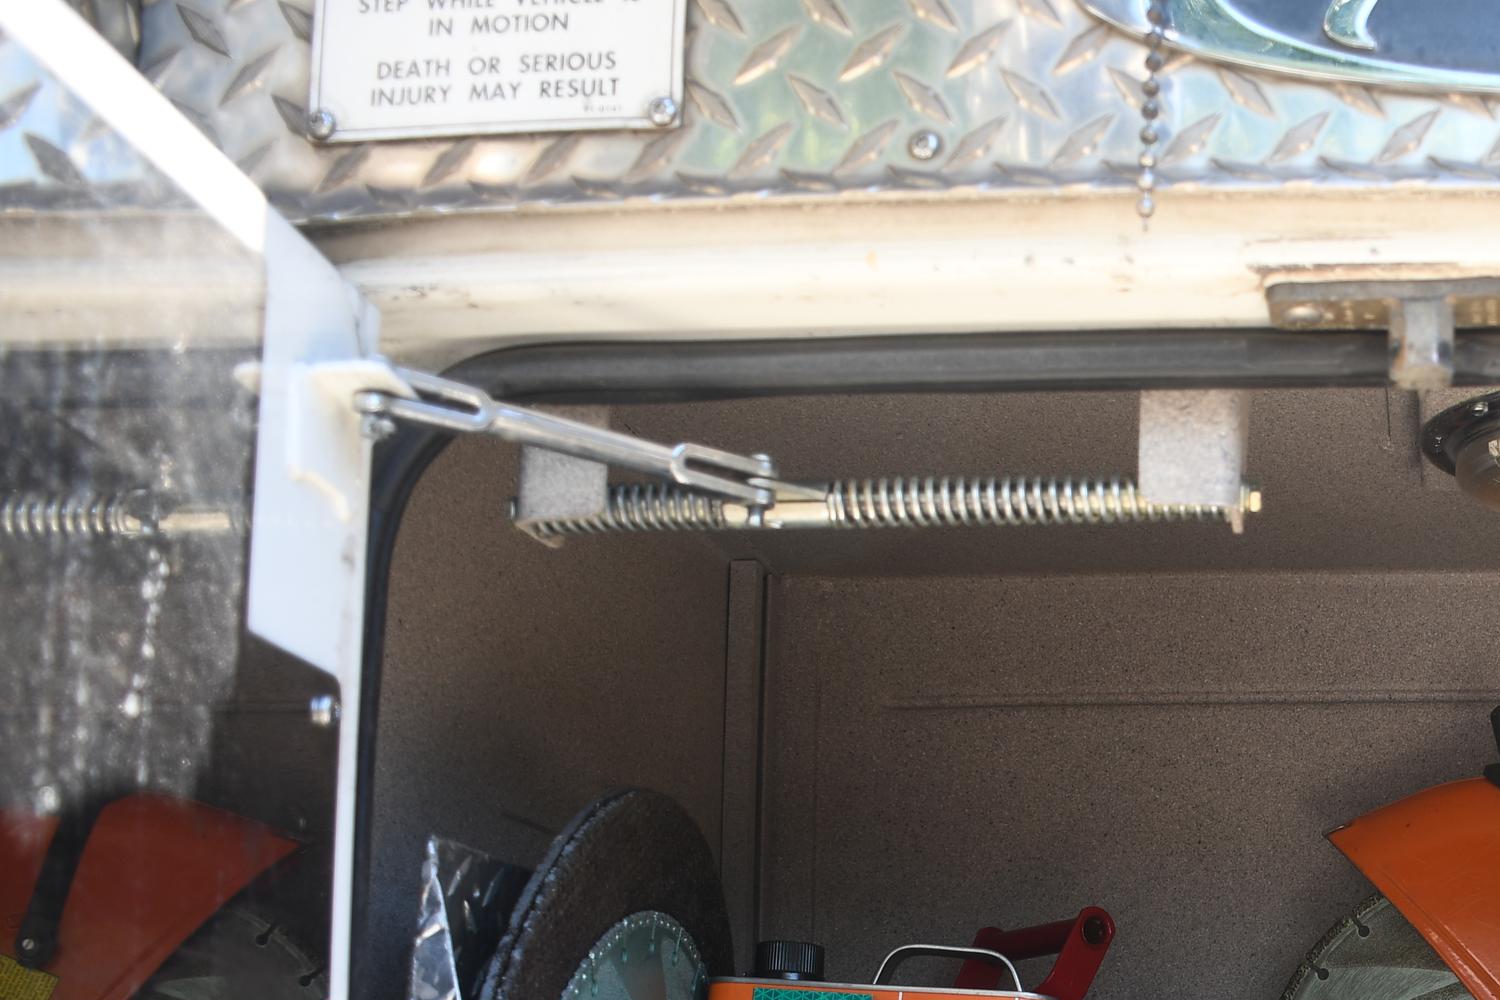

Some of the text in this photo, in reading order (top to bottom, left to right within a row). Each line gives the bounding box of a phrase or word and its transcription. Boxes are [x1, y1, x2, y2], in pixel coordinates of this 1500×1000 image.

[428, 13, 568, 36] IN MOTION
[376, 51, 617, 81] DEATH OR SERIOUS
[370, 77, 620, 107] INJURY MAY RESULT
